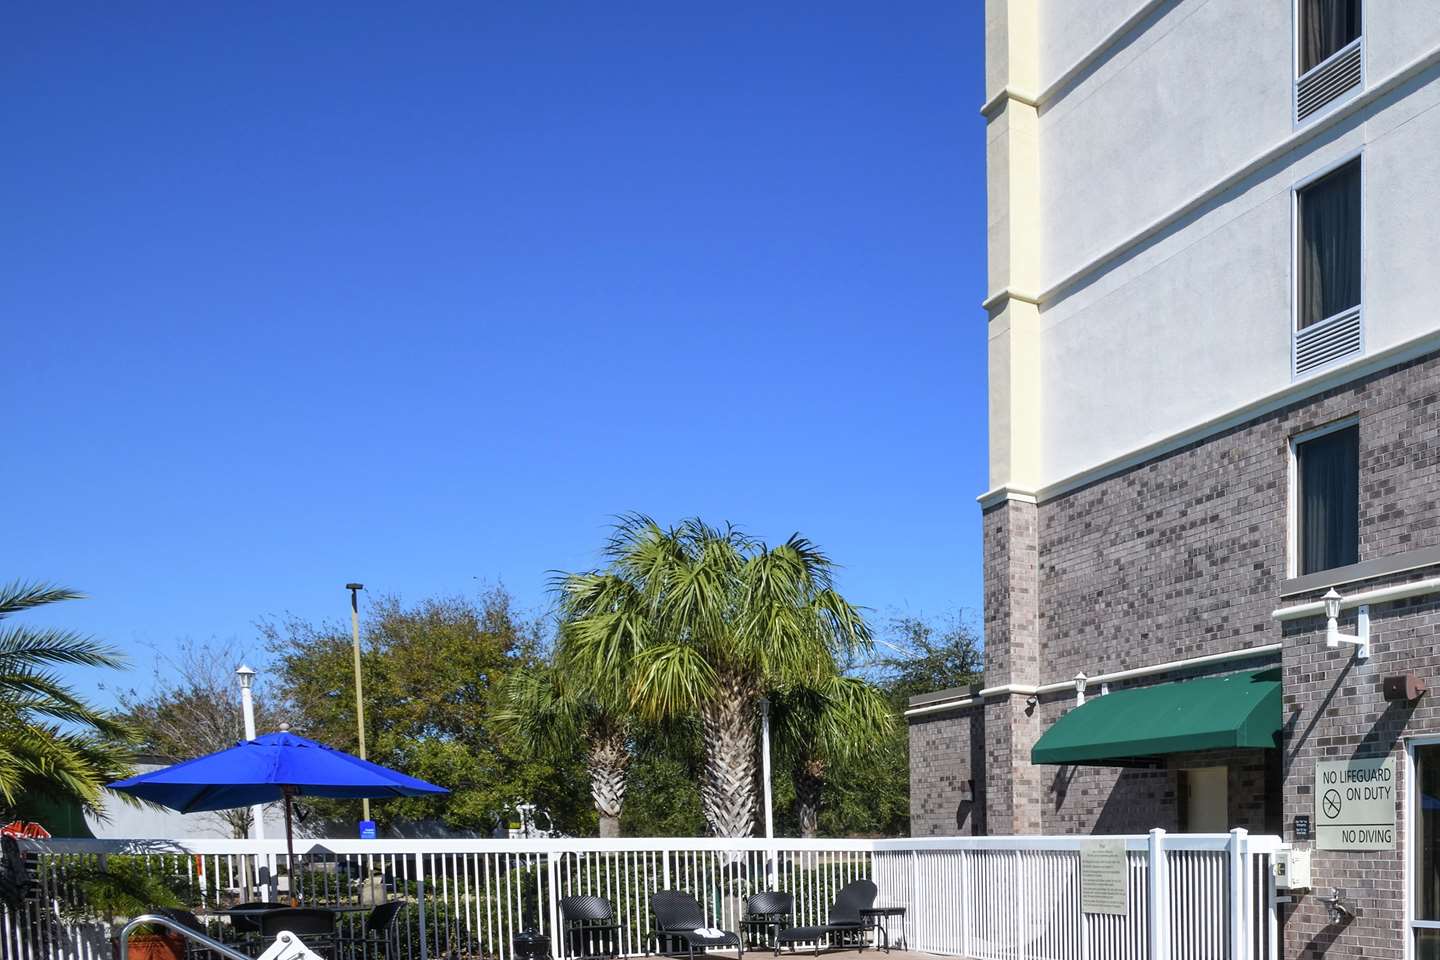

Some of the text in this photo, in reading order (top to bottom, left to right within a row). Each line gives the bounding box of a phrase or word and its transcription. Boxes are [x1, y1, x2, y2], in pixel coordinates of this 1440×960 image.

[1323, 768, 1391, 784] NO LIFEGUARD
[1346, 786, 1391, 801] ON DUTY
[1342, 829, 1392, 843] NO DIVING
